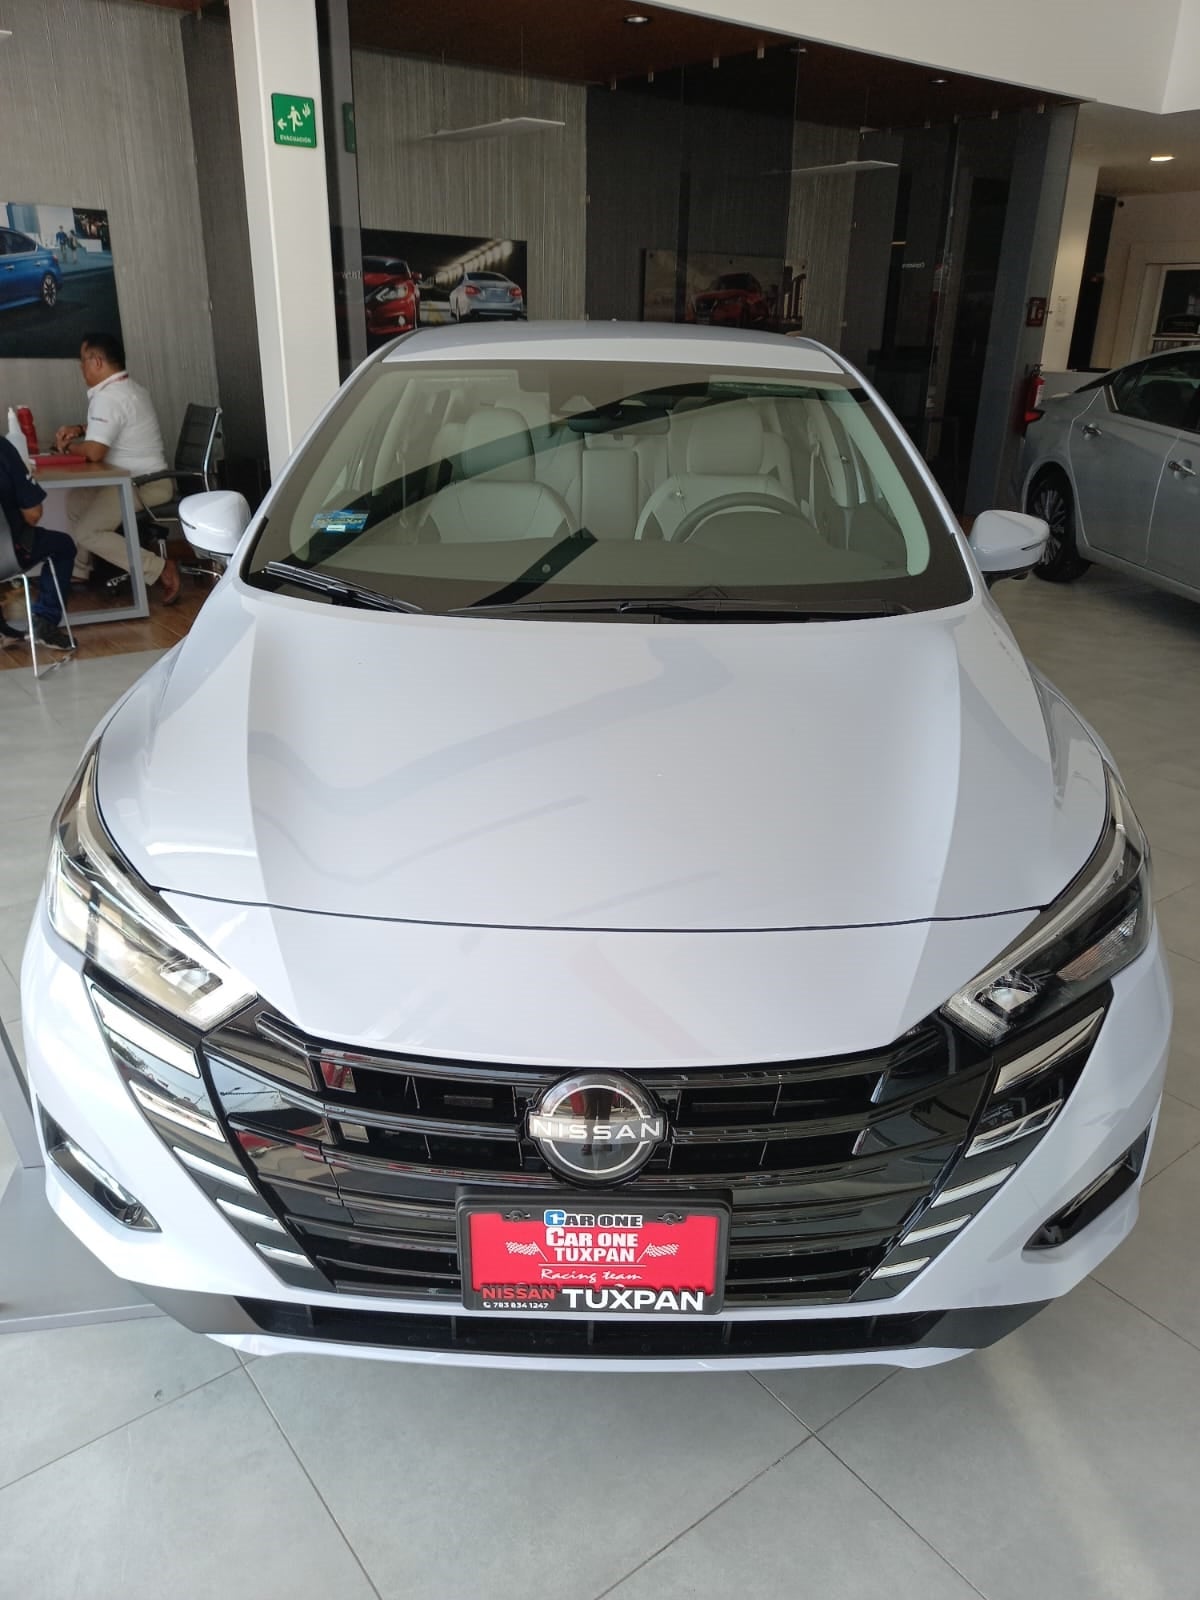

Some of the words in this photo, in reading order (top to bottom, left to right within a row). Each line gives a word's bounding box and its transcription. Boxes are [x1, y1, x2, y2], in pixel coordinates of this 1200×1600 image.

[533, 1117, 660, 1140] NISSAN
[598, 1214, 643, 1228] ONE
[546, 1228, 593, 1247] CAR
[597, 1233, 639, 1247] ONE
[554, 1248, 635, 1262] TUXPAN
[541, 1268, 597, 1284] Racing
[602, 1271, 642, 1280] team
[482, 1287, 556, 1300] NISSAN
[562, 1288, 704, 1311] TUXPAN
